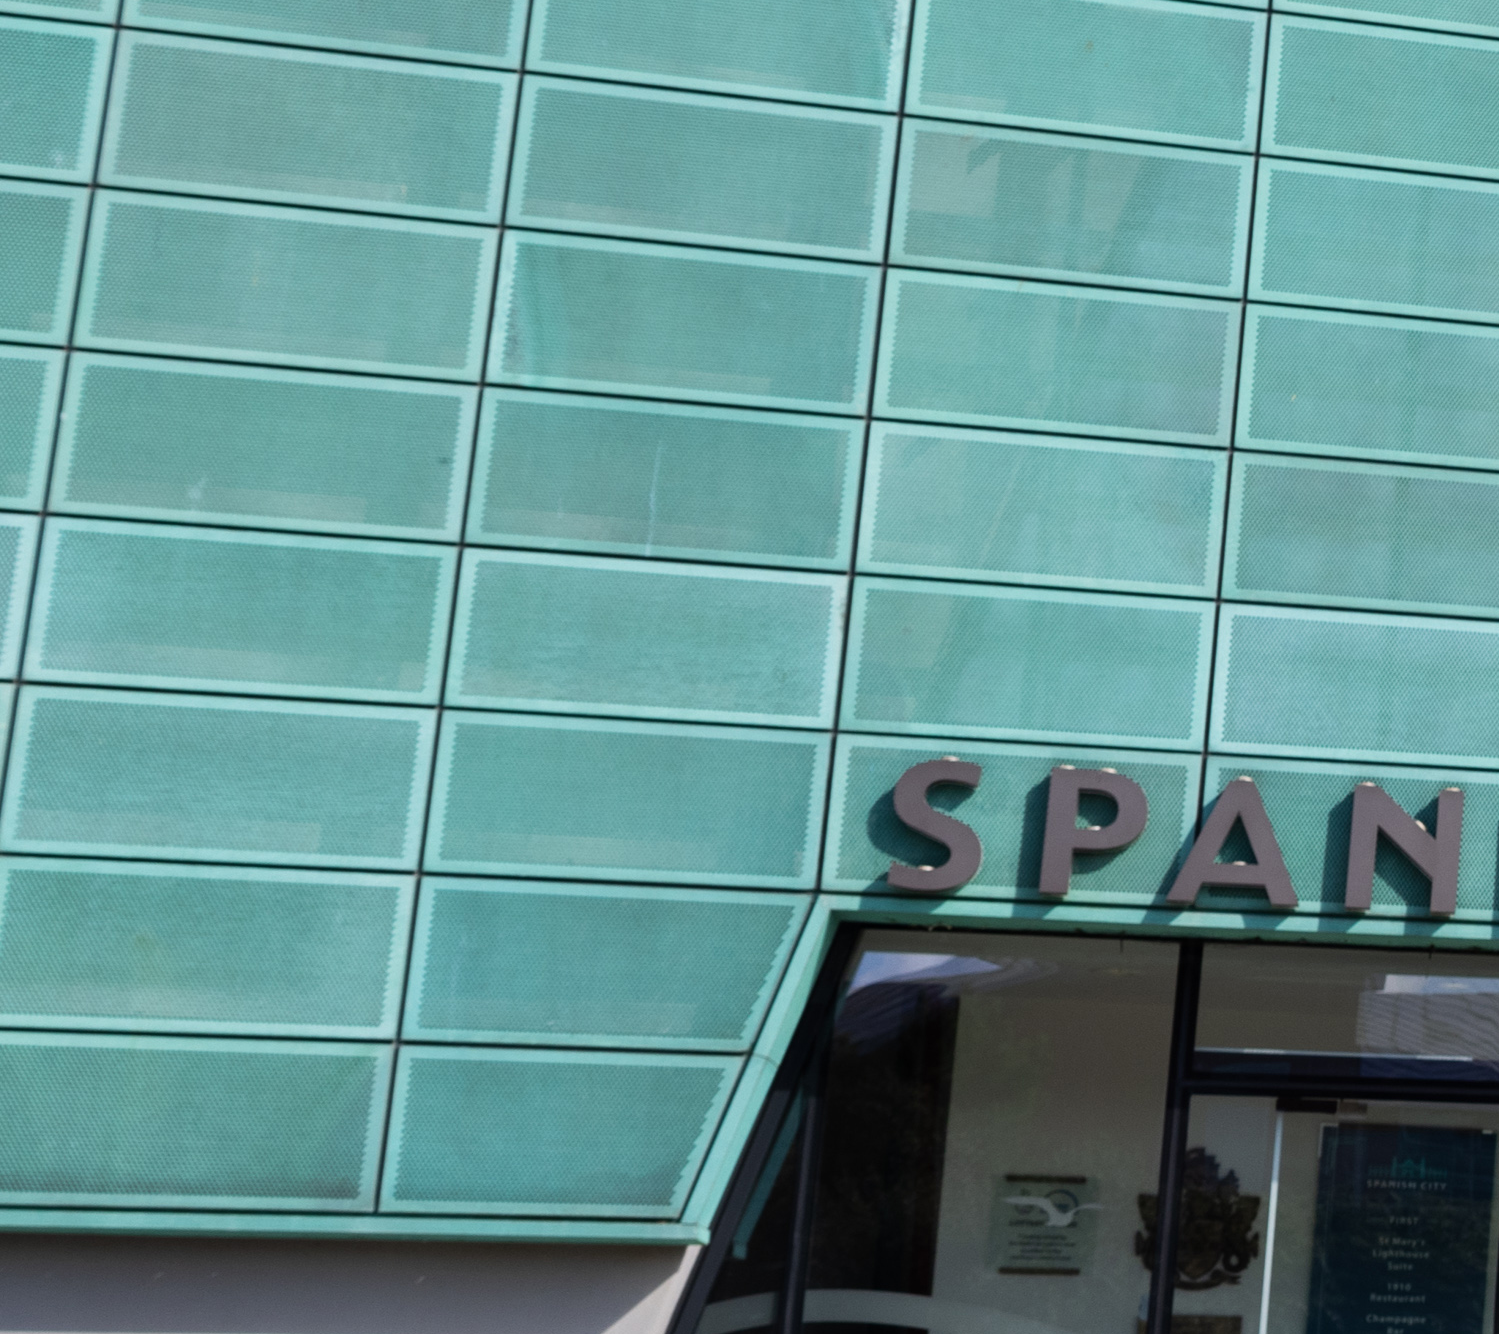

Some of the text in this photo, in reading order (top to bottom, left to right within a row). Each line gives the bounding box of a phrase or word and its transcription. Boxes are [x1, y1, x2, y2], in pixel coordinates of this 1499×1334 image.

[1366, 1179, 1447, 1191] SPANISH CITY
[1389, 1215, 1419, 1225] FIRST
[1378, 1236, 1426, 1247] St Mary's
[1372, 1249, 1430, 1259] Lighthouse
[1387, 1261, 1413, 1271] Suite
[1387, 1282, 1412, 1292] 1910
[1369, 1293, 1426, 1304] Restaurant
[1365, 1314, 1427, 1326] Champagne
